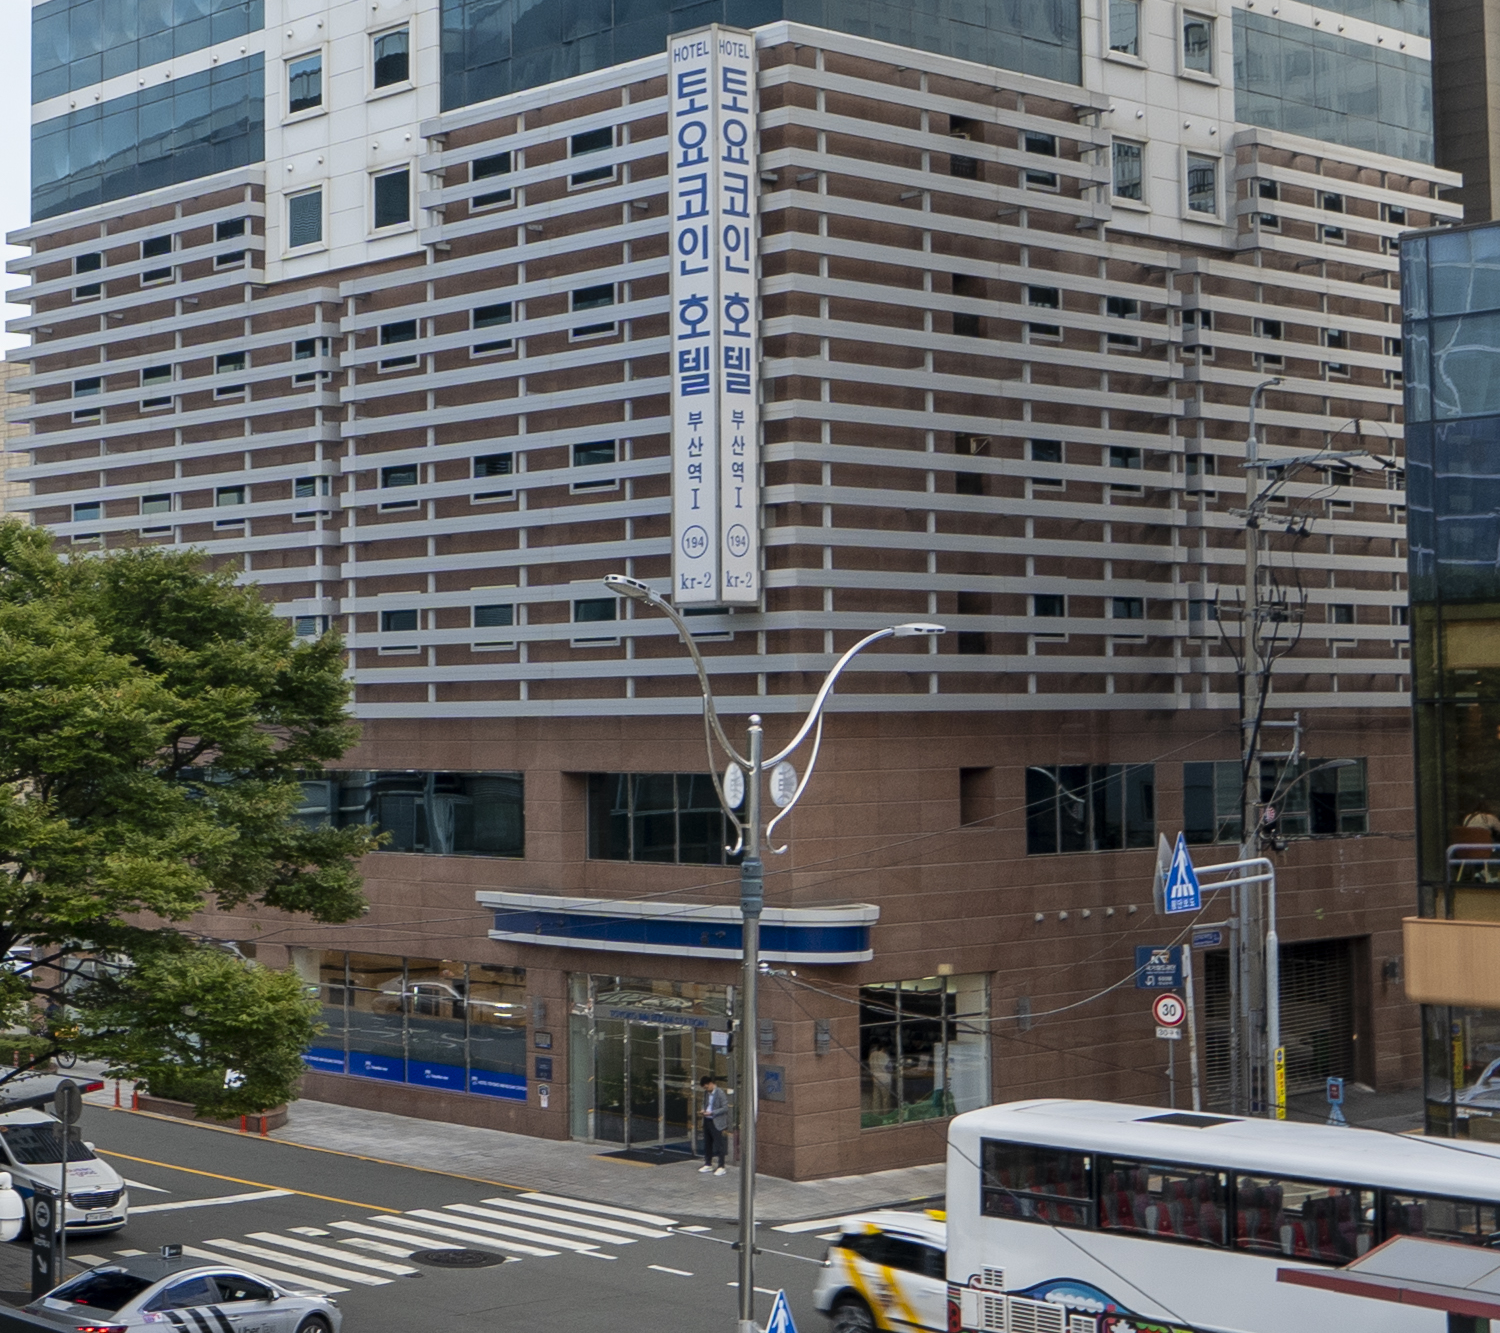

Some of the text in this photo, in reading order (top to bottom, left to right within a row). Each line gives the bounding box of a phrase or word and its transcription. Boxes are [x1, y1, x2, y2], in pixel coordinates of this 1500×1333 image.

[673, 40, 710, 63] HOTEL
[719, 39, 750, 59] HOTEL
[676, 67, 711, 397] 토요코인 호텔
[721, 66, 751, 395] 토요코인 호텔
[685, 536, 704, 549] 194
[729, 535, 747, 548] 194
[680, 571, 712, 590] kr-2
[725, 570, 753, 589] kr-2
[1162, 1003, 1176, 1017] 30
